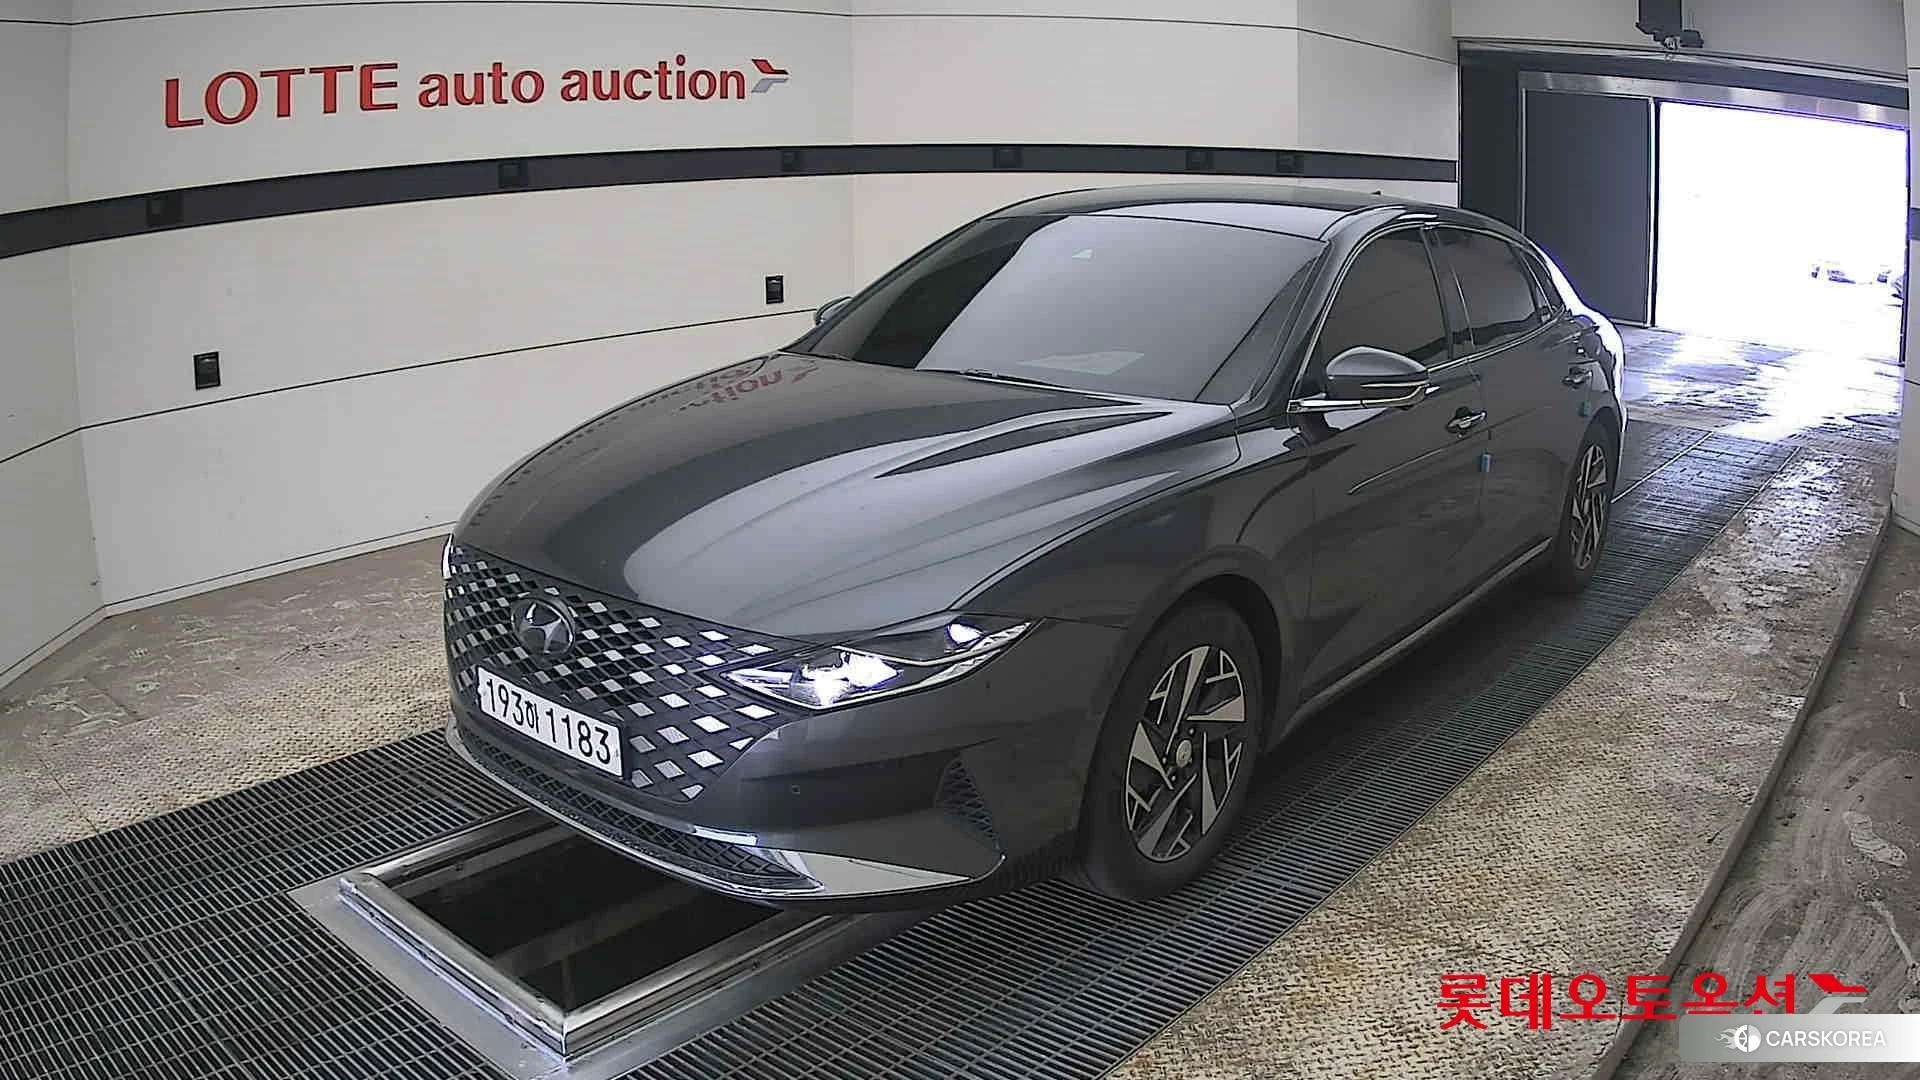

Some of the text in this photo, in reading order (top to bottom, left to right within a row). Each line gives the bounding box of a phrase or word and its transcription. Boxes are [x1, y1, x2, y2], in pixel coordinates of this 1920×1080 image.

[165, 54, 747, 128] LOTTE auto auction
[545, 707, 611, 765] 1183
